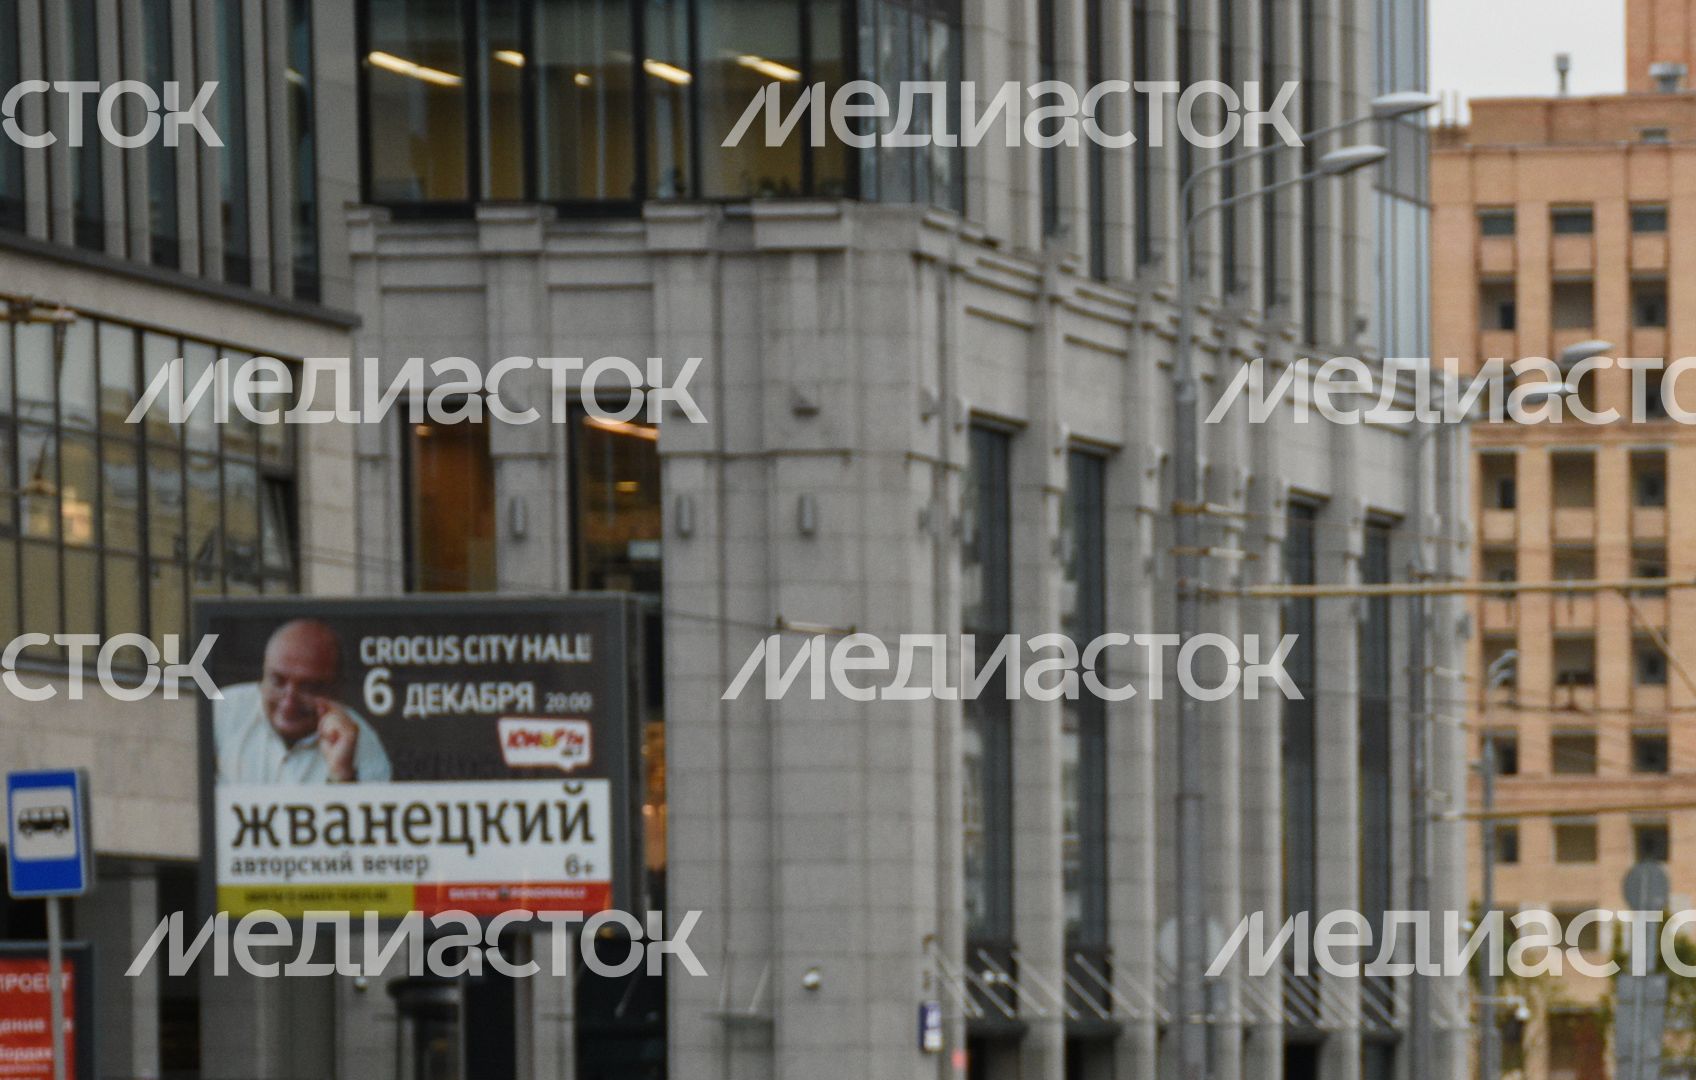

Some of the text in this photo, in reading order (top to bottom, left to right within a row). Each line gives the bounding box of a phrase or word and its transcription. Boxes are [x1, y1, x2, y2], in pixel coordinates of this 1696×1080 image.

[360, 635, 459, 665] CROCUS
[463, 635, 518, 663] CITY
[522, 634, 591, 662] HALL
[363, 667, 394, 715] 6
[403, 681, 535, 719] ДЕКАБРЯ
[231, 851, 430, 880] авторский вечер
[565, 854, 595, 876] 6+
